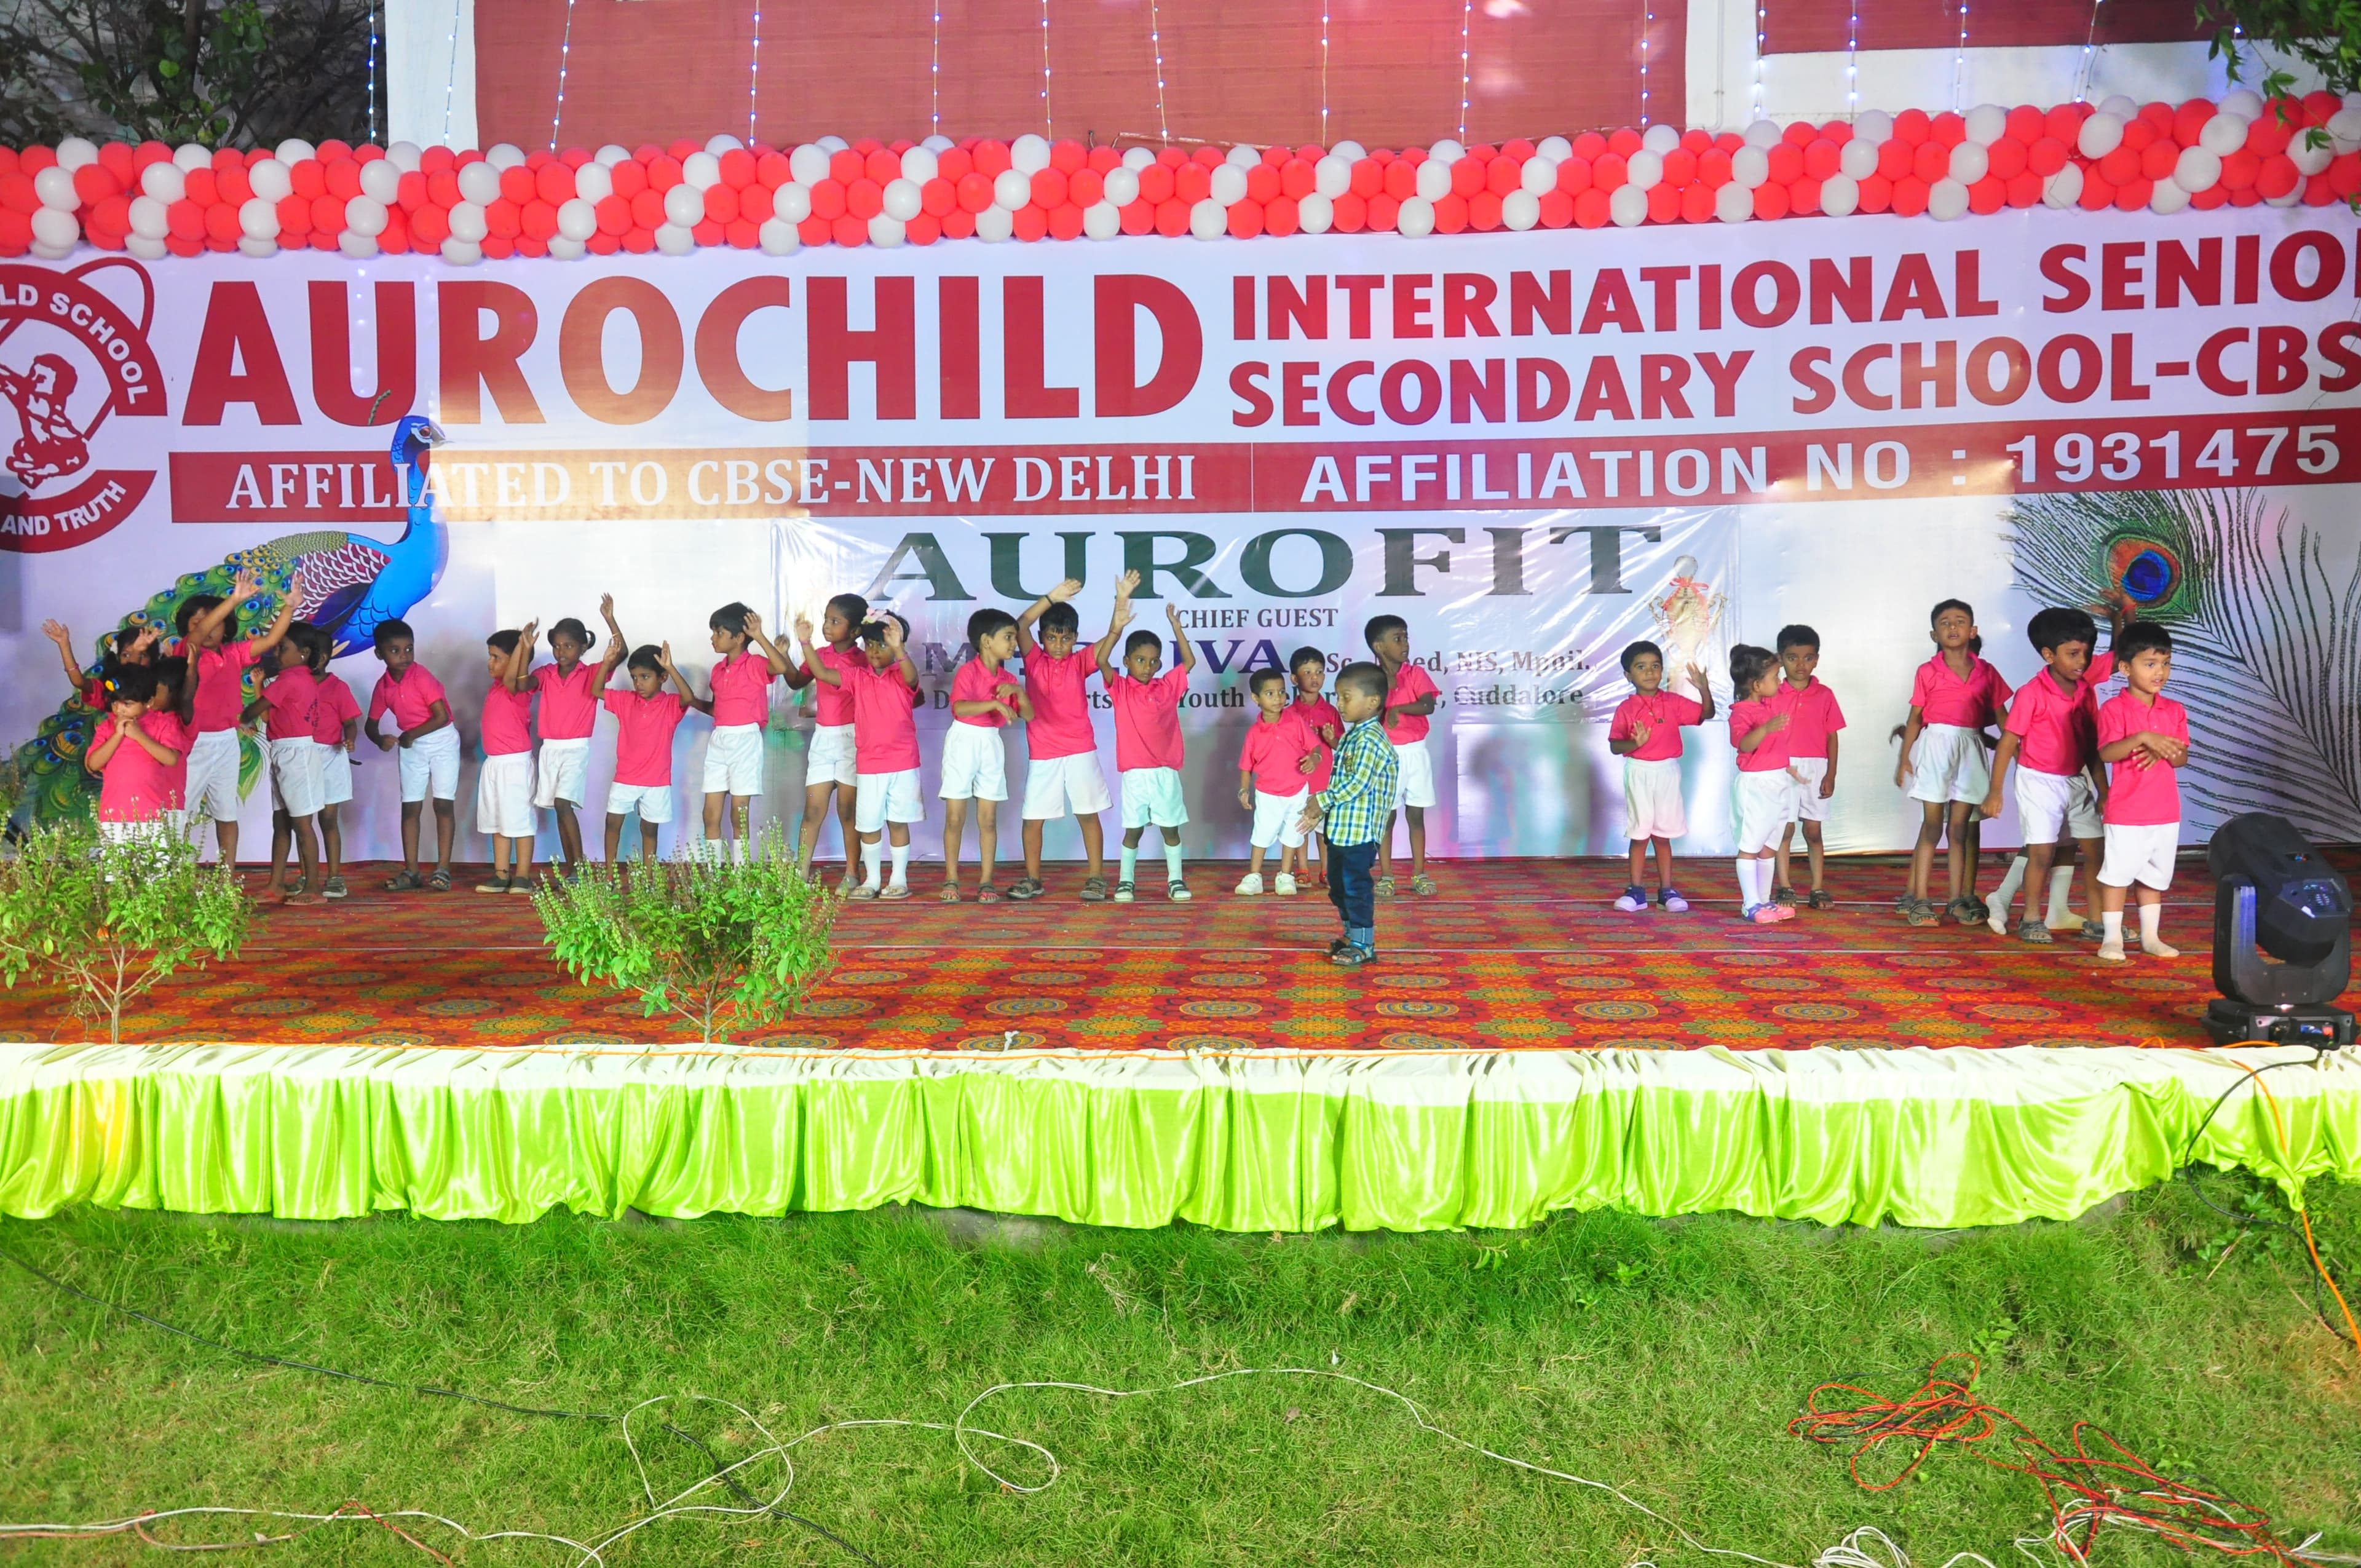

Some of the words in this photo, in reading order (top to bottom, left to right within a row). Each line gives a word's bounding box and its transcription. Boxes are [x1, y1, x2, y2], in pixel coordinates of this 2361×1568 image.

[1232, 249, 1999, 340] INTERNATIONAL
[2039, 228, 2361, 314] SENIO
[50, 292, 148, 404] SCHOOL
[182, 274, 1203, 427] AUROCHILD
[1228, 350, 1755, 427] SECONDARY
[225, 461, 571, 509] AFFILIATED
[588, 459, 668, 507] TO
[687, 457, 996, 505] CBSE-NEW
[1013, 454, 1195, 502] DELHI
[1299, 446, 1767, 502] AFFILIATION
[1806, 440, 1910, 491] NO
[2006, 424, 2339, 483] 1931475
[1, 515, 50, 536] AND
[53, 480, 127, 532] TRUTH
[862, 525, 1662, 603] AUROFIT
[1179, 609, 1249, 628] CHIEF
[1257, 608, 1339, 627] GUEST
[1177, 686, 1245, 708] Youth
[1453, 684, 1584, 705] Cuddalore
